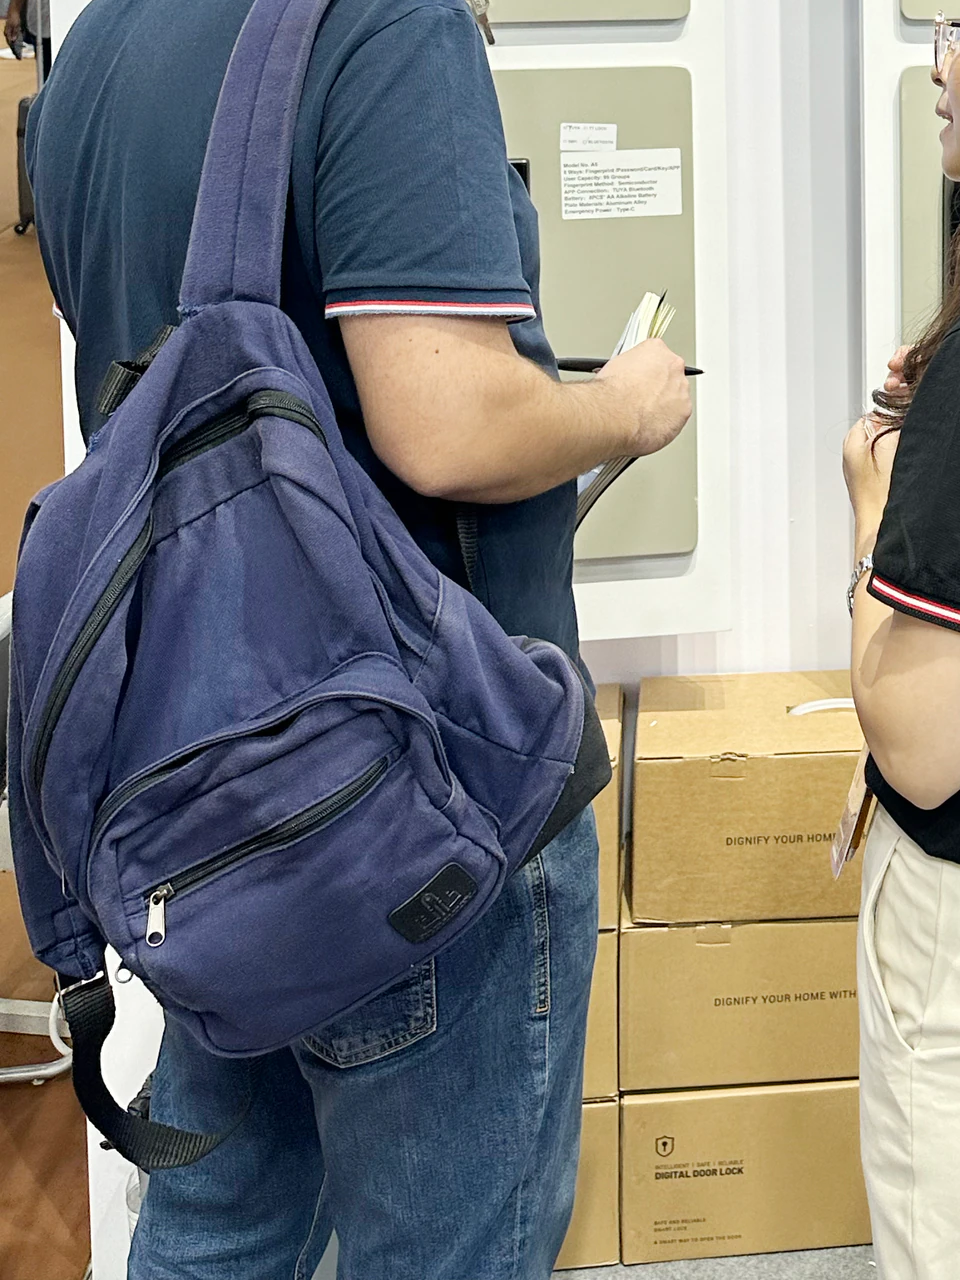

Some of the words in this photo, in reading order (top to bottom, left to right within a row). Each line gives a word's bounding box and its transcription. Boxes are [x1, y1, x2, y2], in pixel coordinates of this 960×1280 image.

[726, 835, 771, 846] DIGNIFY
[774, 834, 804, 844] YOUR
[714, 996, 758, 1007] DIGNIFY
[762, 993, 791, 1004] YOUR
[794, 991, 826, 1002] HOME
[829, 989, 857, 1000] WITH
[655, 1170, 691, 1180] DIGITAL
[693, 1168, 718, 1178] DOOR
[719, 1167, 744, 1176] LOCK
